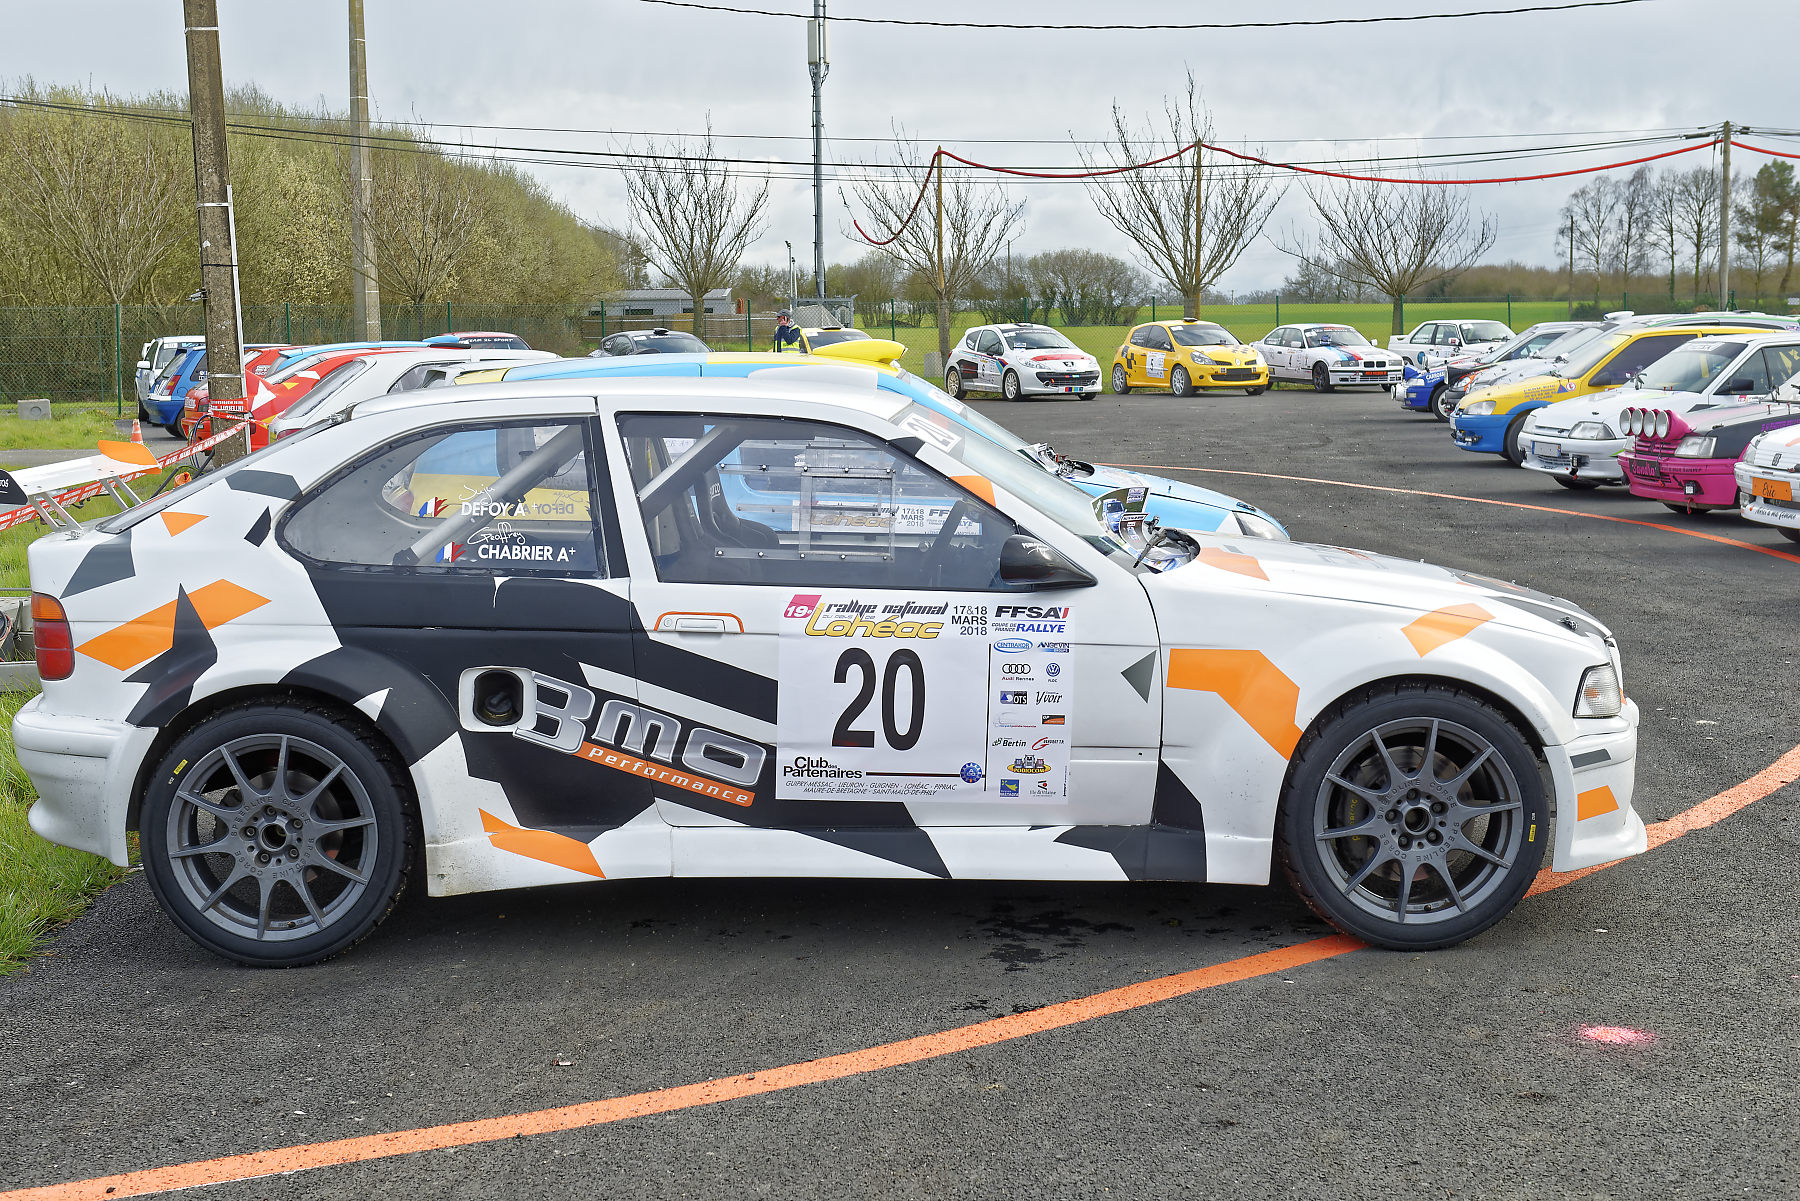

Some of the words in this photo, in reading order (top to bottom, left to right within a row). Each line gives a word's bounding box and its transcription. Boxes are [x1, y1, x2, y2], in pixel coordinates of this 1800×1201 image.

[906, 417, 955, 447] 20
[461, 501, 510, 517] DEFOY
[478, 544, 553, 561] CHABRIER
[556, 546, 577, 562] A+
[825, 600, 878, 618] rallye
[881, 600, 949, 619] national
[953, 605, 988, 615] 17&18
[995, 606, 1061, 619] FFSA
[804, 602, 945, 639] Lohéac
[951, 615, 988, 625] MARS
[960, 625, 988, 636] 2018
[1016, 623, 1066, 633] RALLYE
[832, 647, 926, 751] 20
[1013, 696, 1027, 704] OTS
[1036, 691, 1062, 705] Yvoir
[794, 757, 829, 769] Club
[589, 747, 748, 804] Performance
[783, 766, 862, 778] Partenaires
